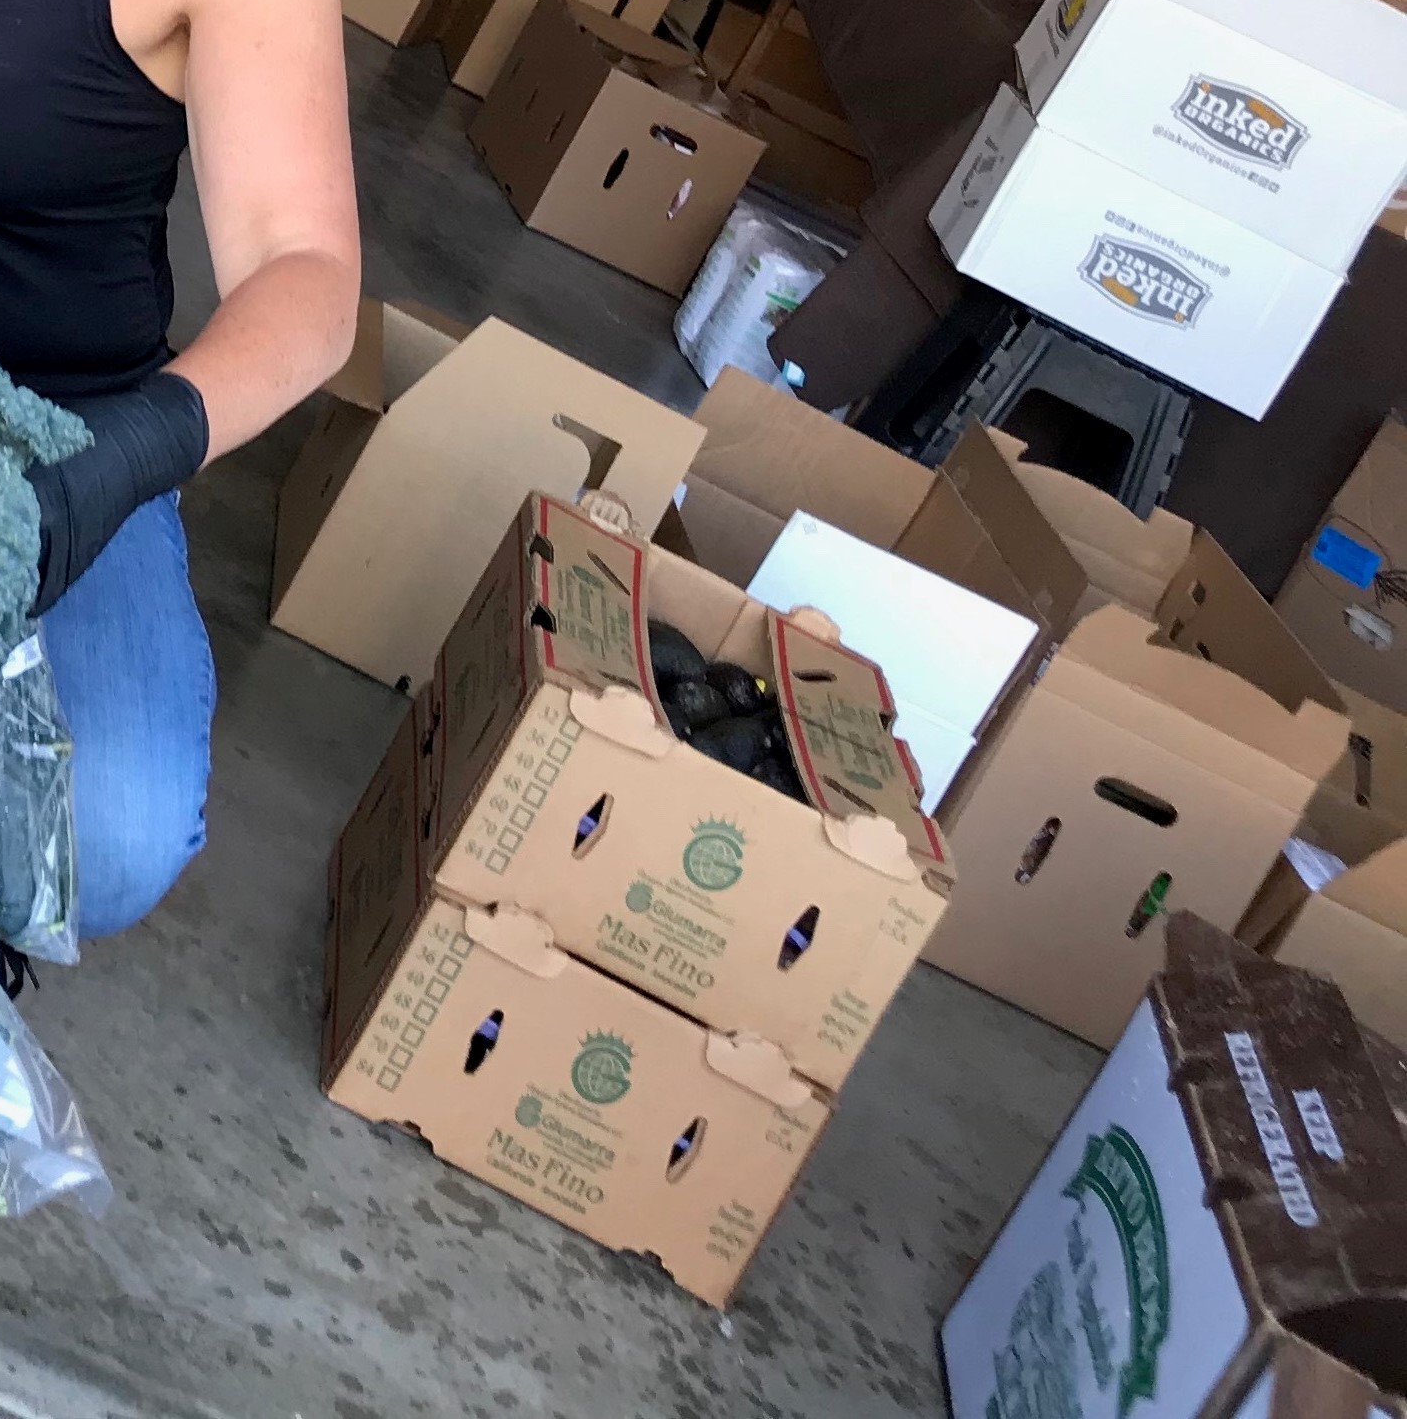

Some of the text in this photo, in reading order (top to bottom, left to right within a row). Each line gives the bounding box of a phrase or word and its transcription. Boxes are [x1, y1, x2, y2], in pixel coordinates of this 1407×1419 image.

[1183, 105, 1287, 164] ORGANICS
[1190, 78, 1293, 149] inked
[1090, 253, 1198, 324] inked
[1098, 241, 1203, 300] ORGANICS
[595, 912, 720, 991] Mas Fino
[485, 1127, 610, 1206] Mas Fino
